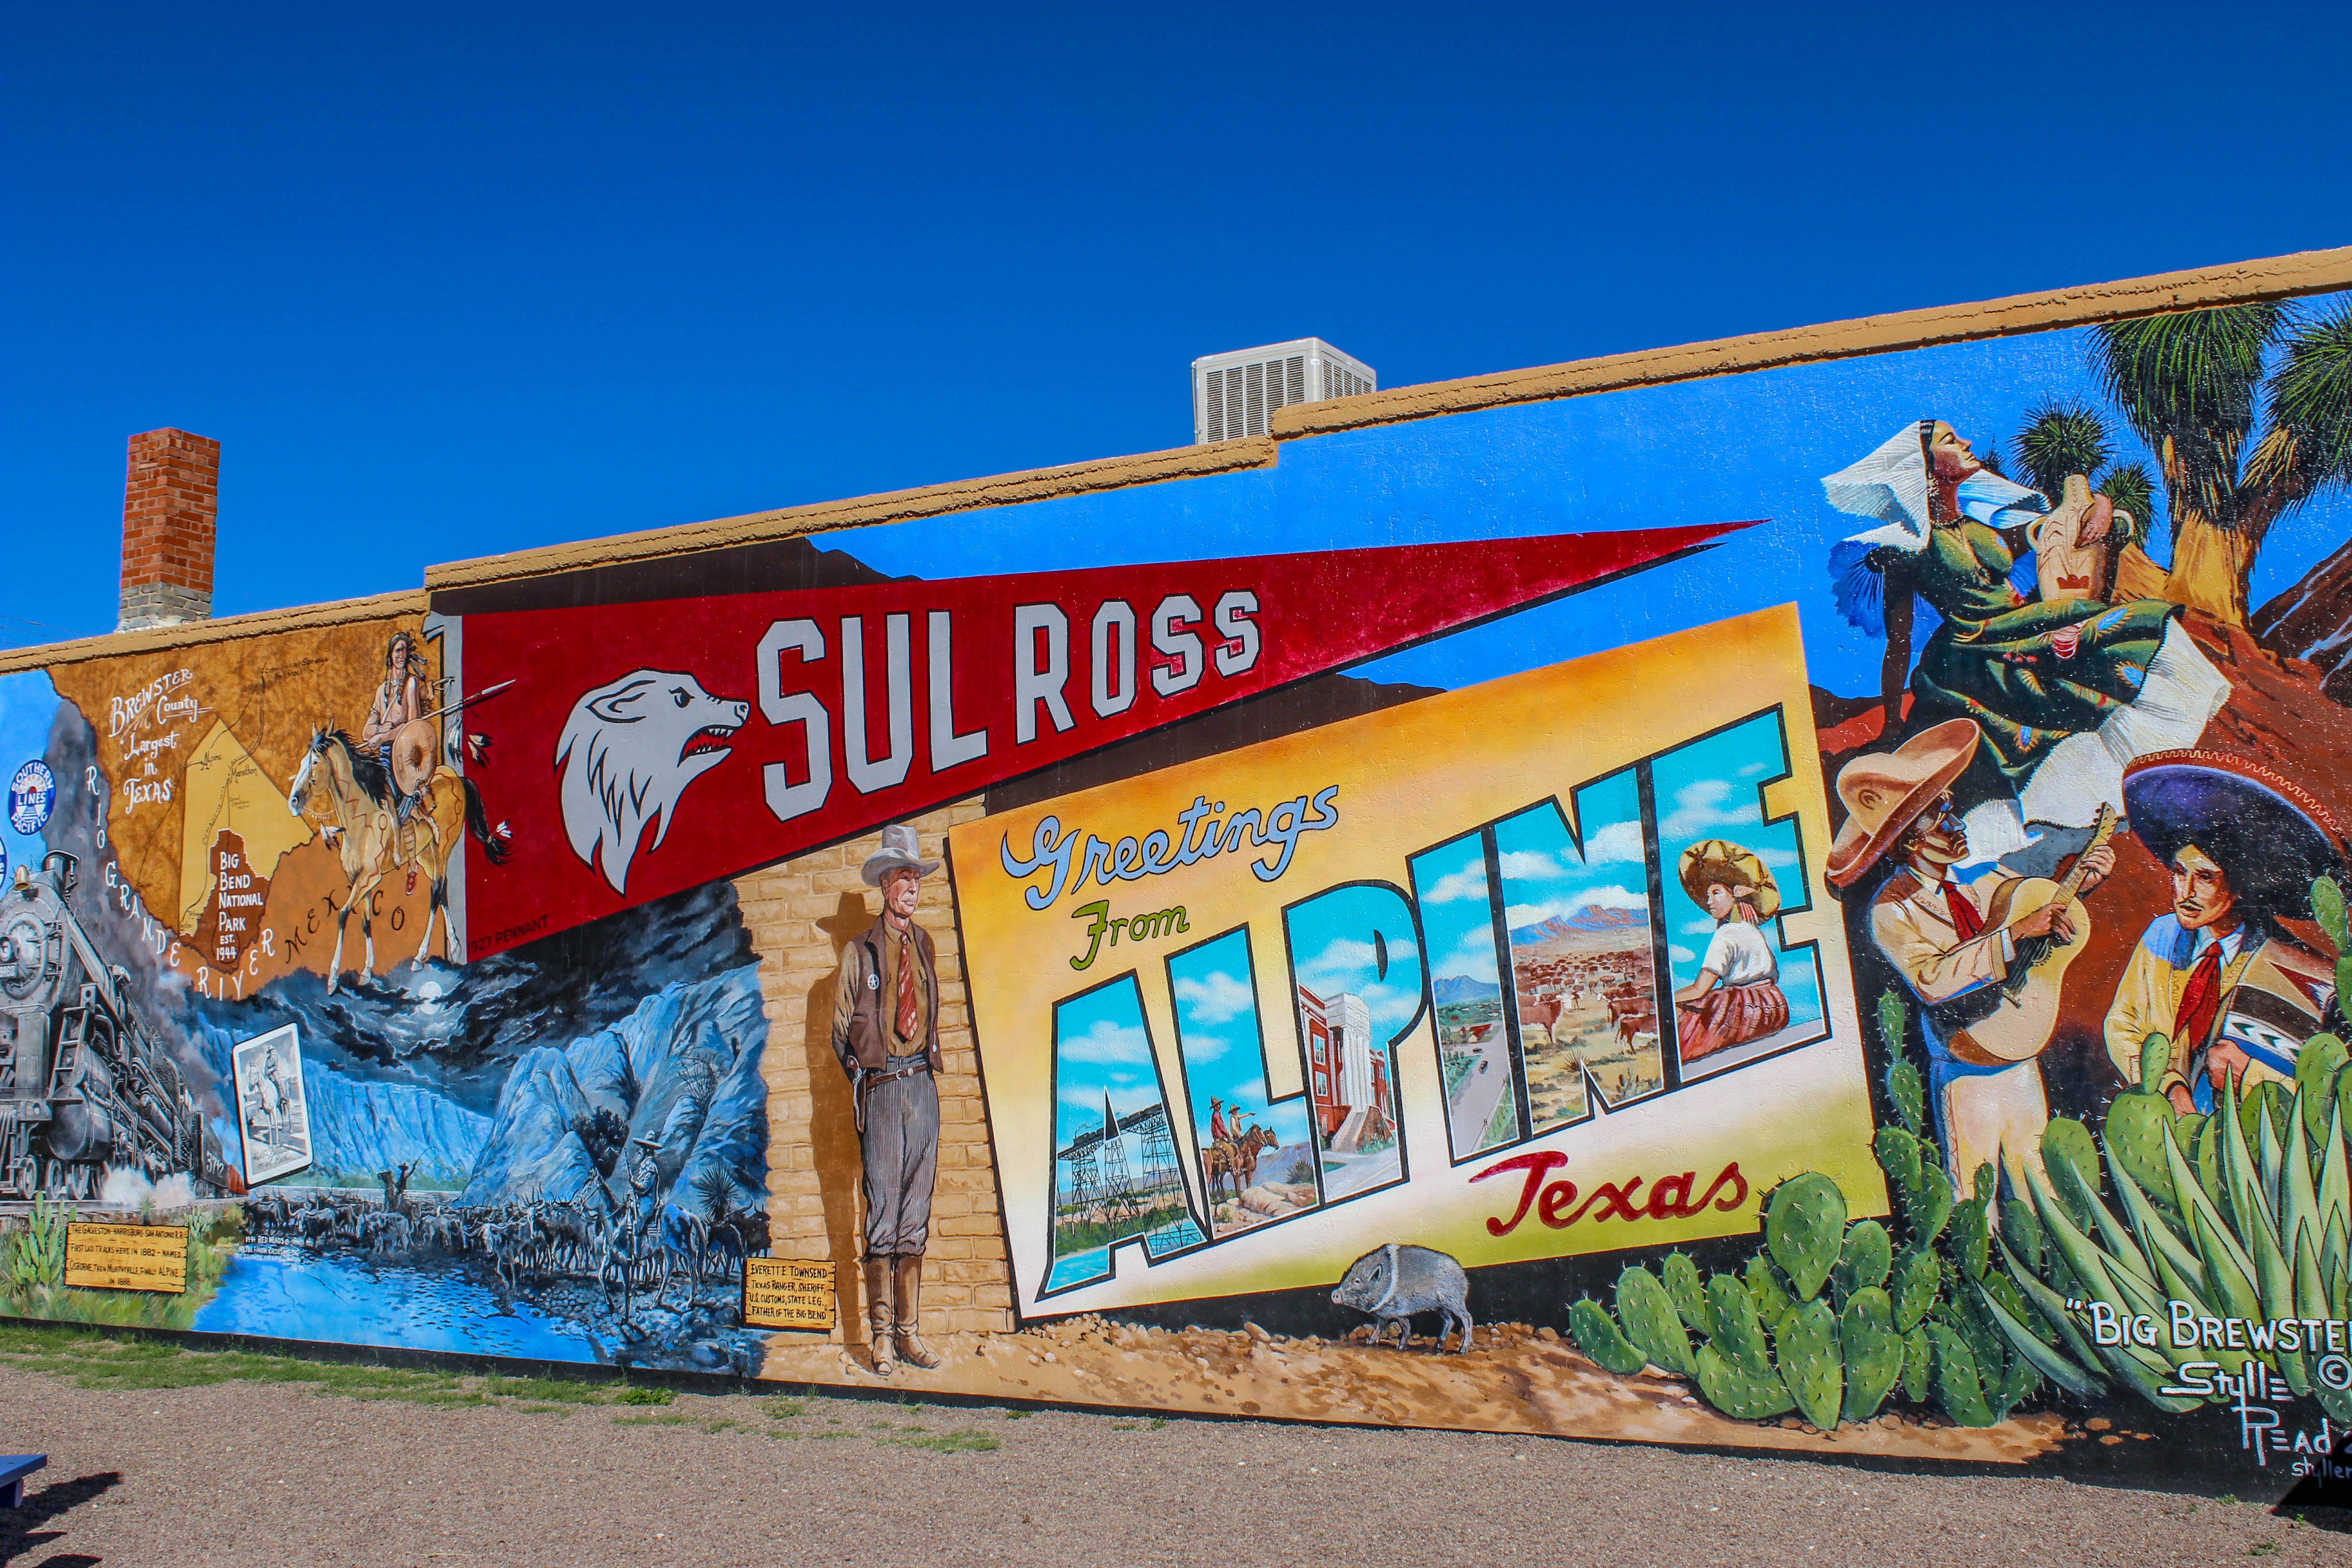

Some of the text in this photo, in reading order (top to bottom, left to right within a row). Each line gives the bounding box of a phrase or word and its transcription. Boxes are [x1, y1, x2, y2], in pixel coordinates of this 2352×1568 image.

[109, 668, 193, 737] BREWSTER
[157, 694, 198, 725] County
[756, 588, 1261, 823] SUL ROSS
[124, 730, 180, 760] Largest
[145, 757, 157, 776] in
[200, 751, 221, 770] Alpine
[11, 762, 54, 792] SOUTHERN
[229, 764, 257, 784] Marathon
[17, 792, 45, 805] LINES
[123, 778, 172, 814] TEXAS
[10, 811, 48, 833] PACIFIC
[1001, 785, 1338, 910] Greetings
[220, 851, 239, 870] BIG
[86, 765, 106, 849] RIO
[197, 928, 275, 1001] RIVER
[220, 872, 251, 891] BEND
[218, 892, 264, 909] NATIONAL
[219, 911, 246, 931] PARK
[220, 934, 235, 945] EST.
[467, 915, 549, 954] 1927 PENNANT
[1069, 900, 1190, 971] From
[216, 946, 237, 960] 1944
[1035, 703, 1832, 1302] ALPINE
[1468, 1150, 1748, 1237] Texas
[71, 1225, 82, 1234] THE
[71, 1243, 83, 1252] FIRST
[141, 1248, 156, 1256] 1882
[162, 1250, 181, 1258] NAMED
[159, 1266, 179, 1277] ALPINE
[750, 1264, 827, 1278] EVERETT E. TOWNSEND
[751, 1279, 826, 1295] TEXAS RANGER, SHERIFF,
[749, 1292, 760, 1303] U.S.
[788, 1295, 806, 1305] STATE
[776, 1308, 782, 1317] OF
[784, 1308, 794, 1318] THE
[796, 1309, 806, 1318] BIG
[2167, 1300, 2352, 1352] BREWSTE
